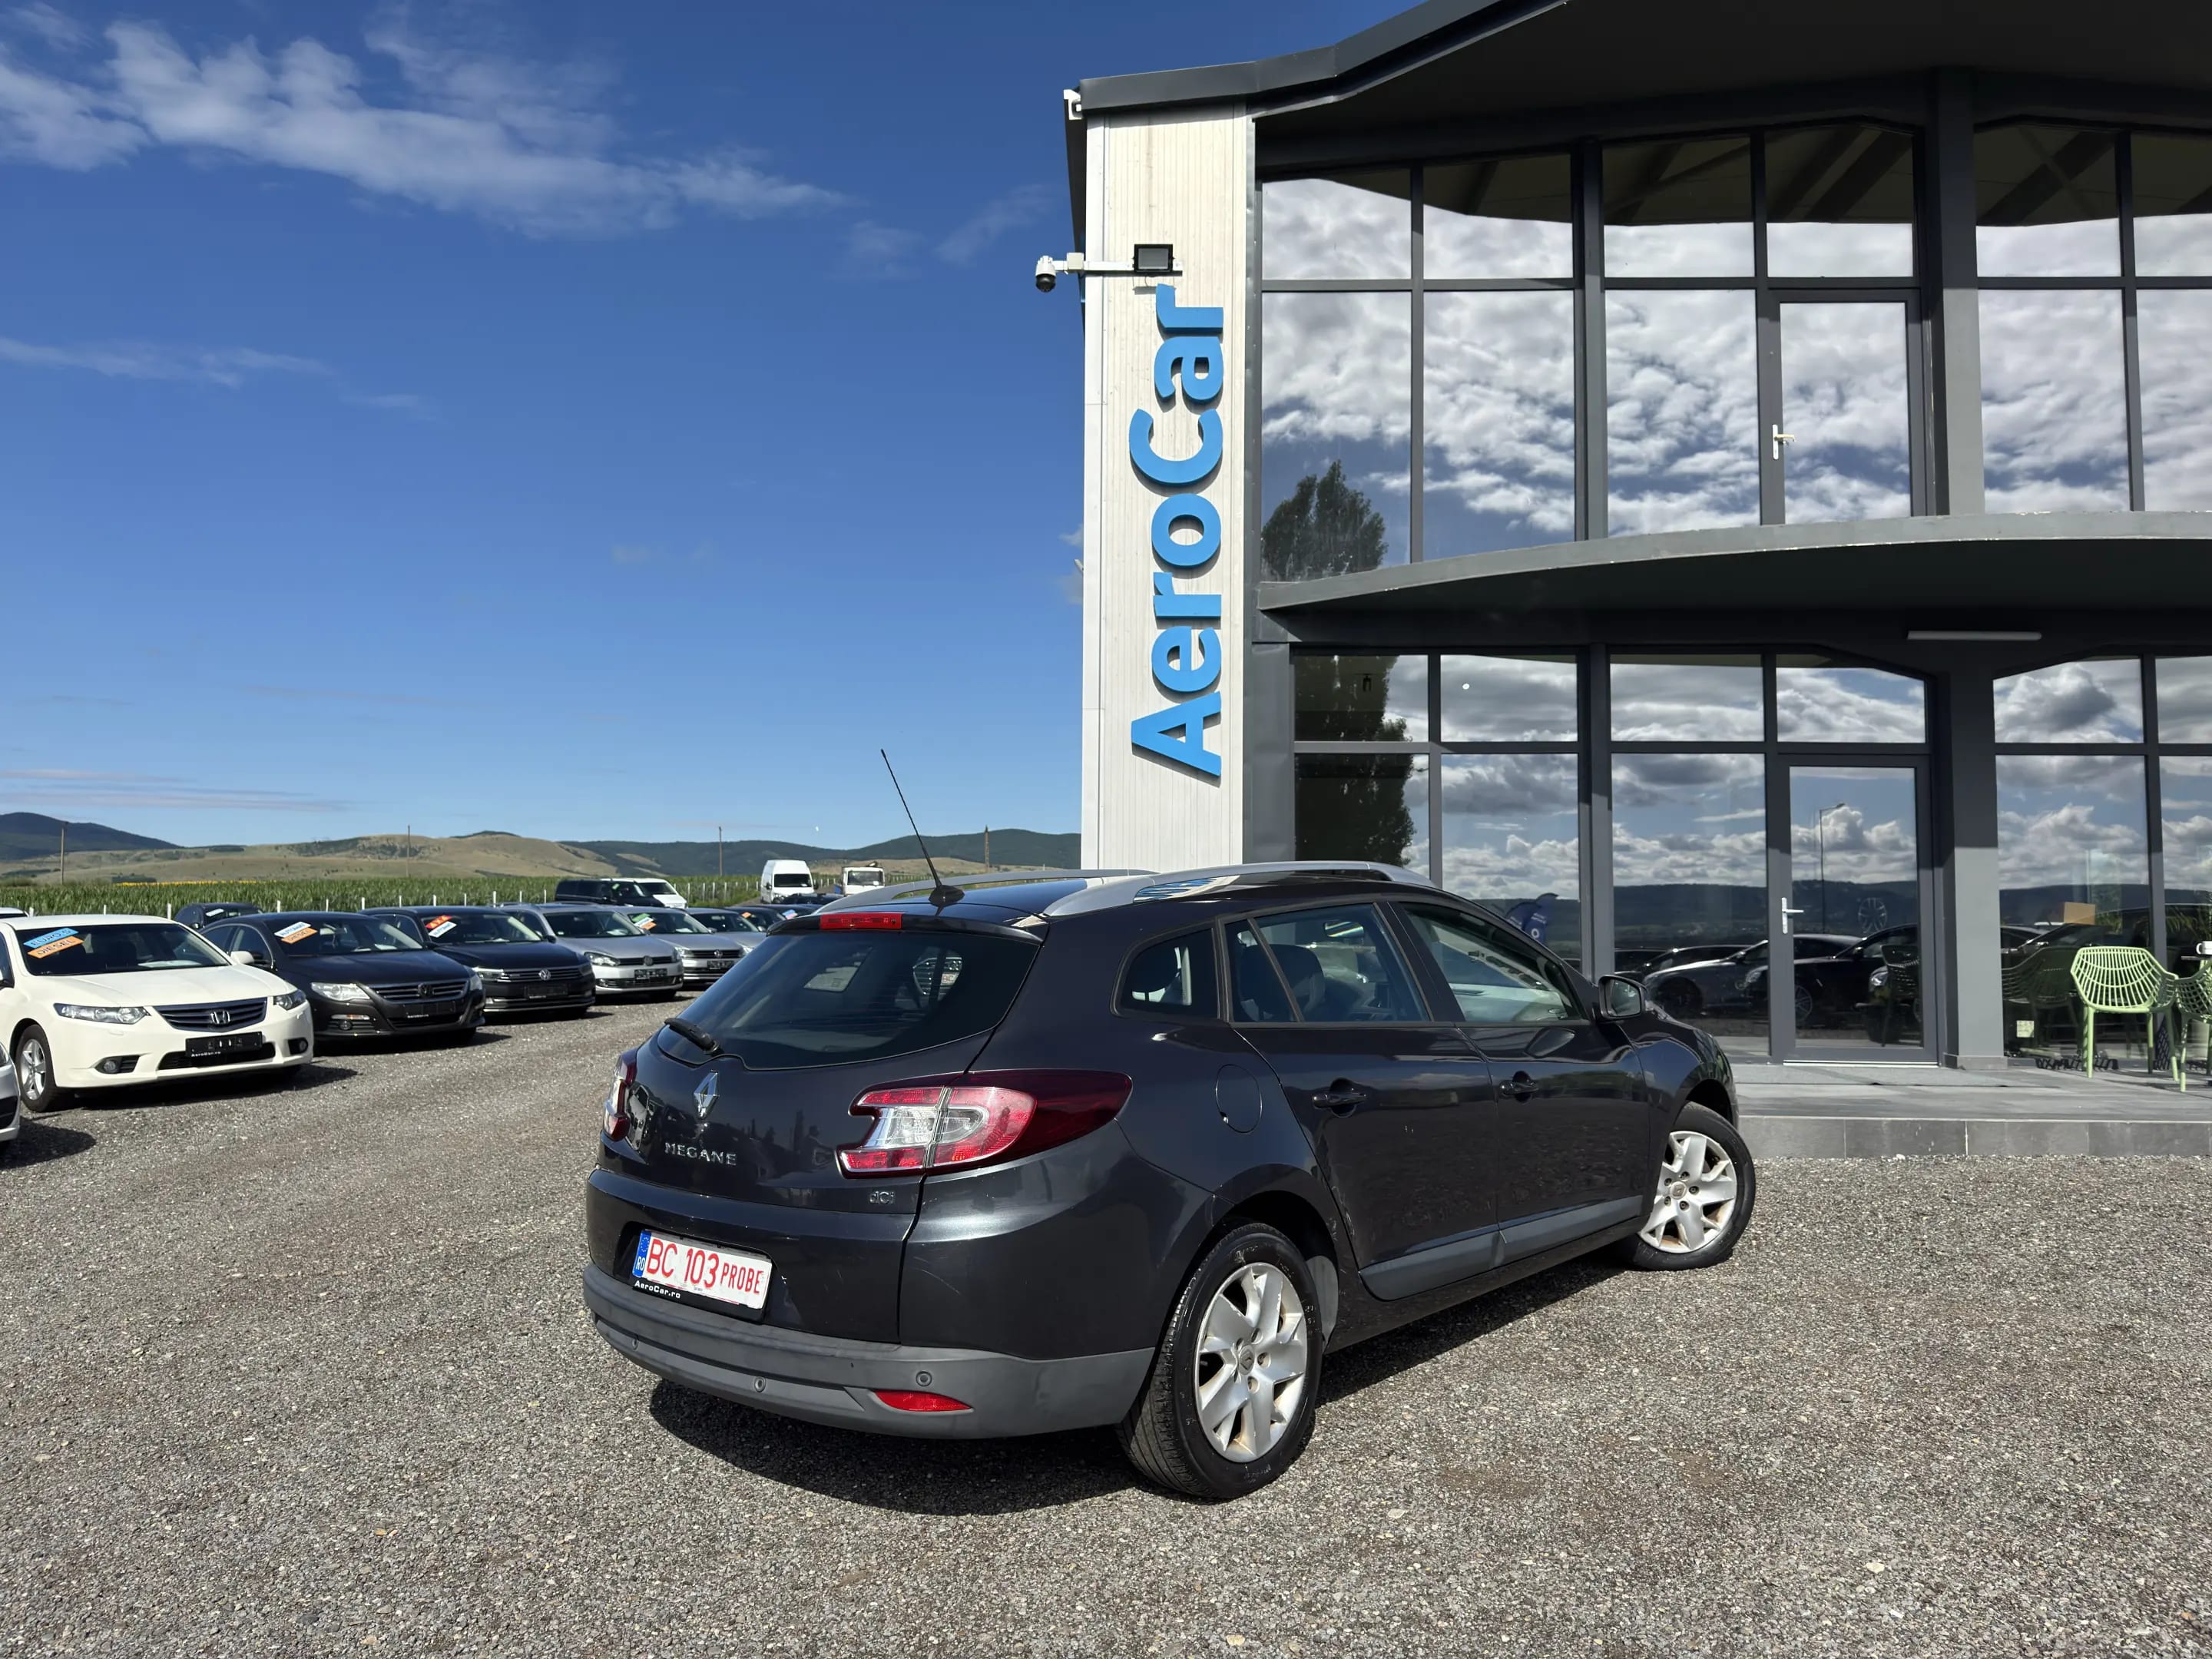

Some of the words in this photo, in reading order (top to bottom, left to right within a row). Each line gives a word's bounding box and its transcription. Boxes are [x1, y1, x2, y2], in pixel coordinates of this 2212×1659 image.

[1129, 283, 1224, 777] AeroCar
[36, 939, 75, 955] DIESEL
[664, 1142, 737, 1166] MEGANE
[637, 1256, 646, 1270] RO
[646, 1238, 677, 1278] BC
[684, 1247, 720, 1288] 103
[720, 1262, 764, 1294] PROBE
[634, 1280, 681, 1299] AeroCar.ro
